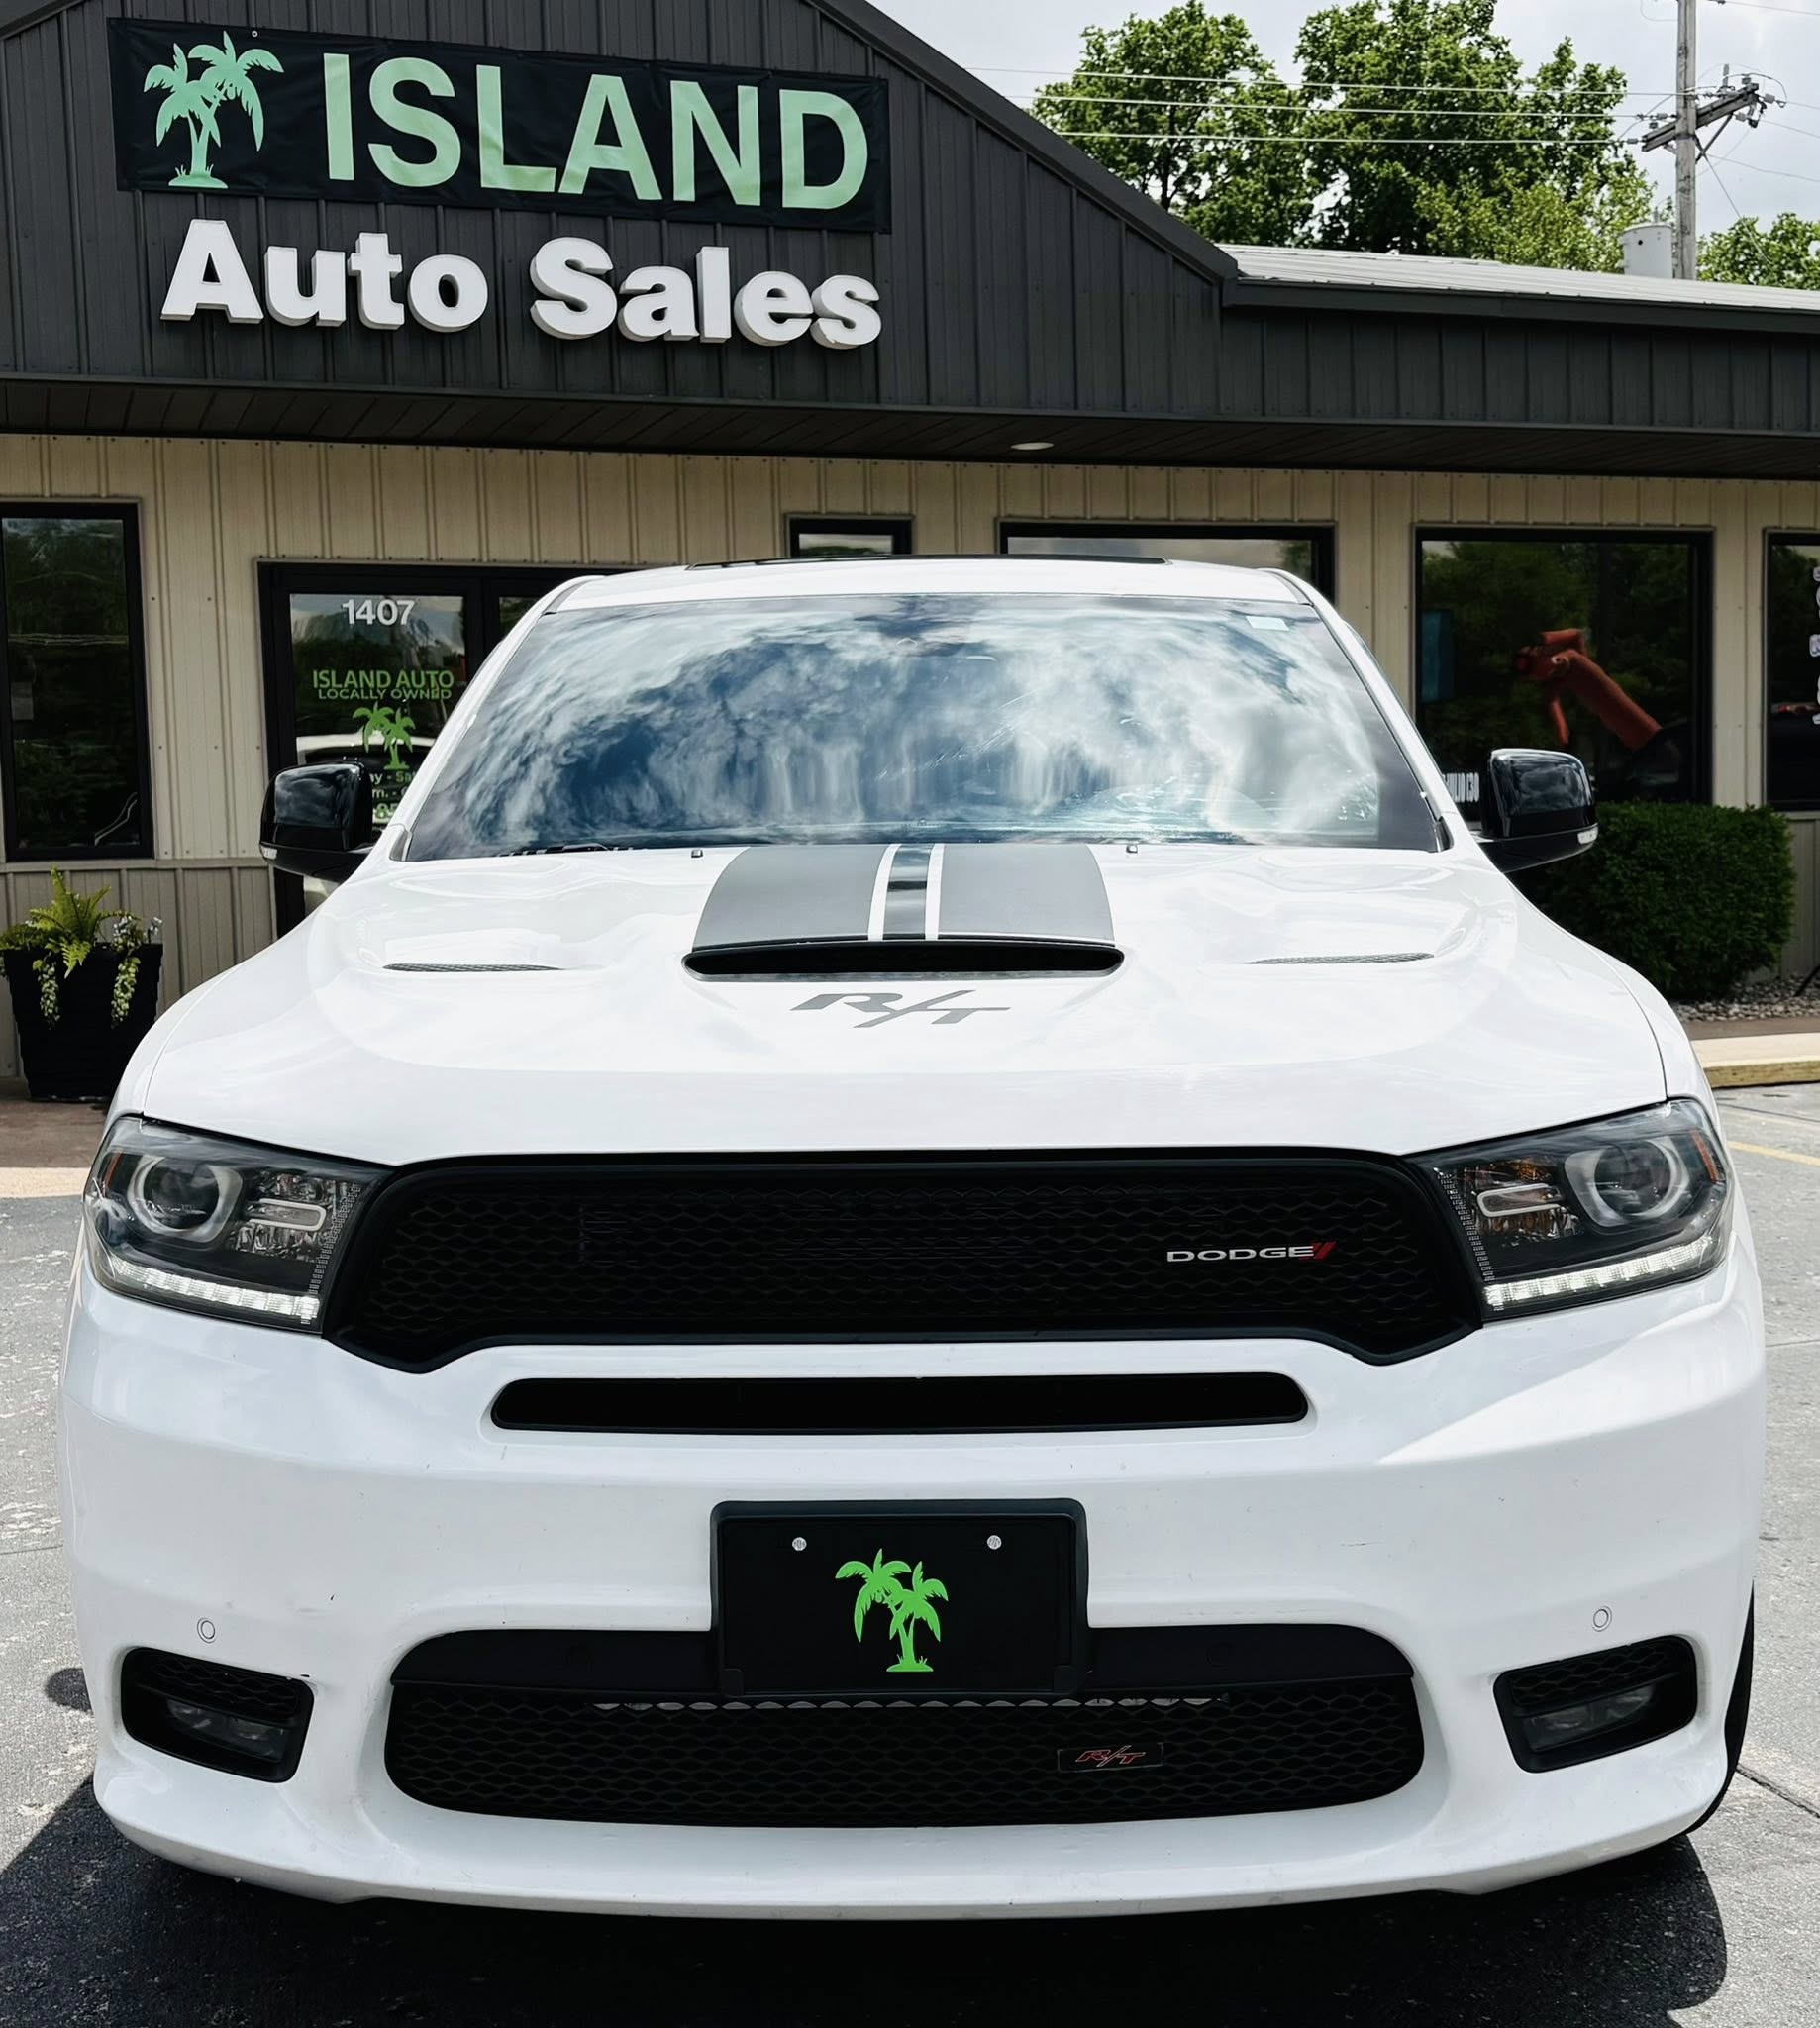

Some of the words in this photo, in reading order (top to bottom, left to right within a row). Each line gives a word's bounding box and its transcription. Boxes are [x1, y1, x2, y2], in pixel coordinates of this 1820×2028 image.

[323, 53, 868, 210] ISLAND
[160, 218, 489, 333] Auto
[529, 236, 882, 351] Sales
[342, 598, 415, 626] 1407
[313, 669, 391, 689] ISLAND
[395, 669, 455, 689] AUTO
[318, 688, 386, 700] LOCALLY
[390, 688, 452, 700] OWNED
[790, 990, 1011, 1029] R/T
[1166, 1245, 1315, 1263] DODGE
[1075, 1745, 1146, 1768] R/T
